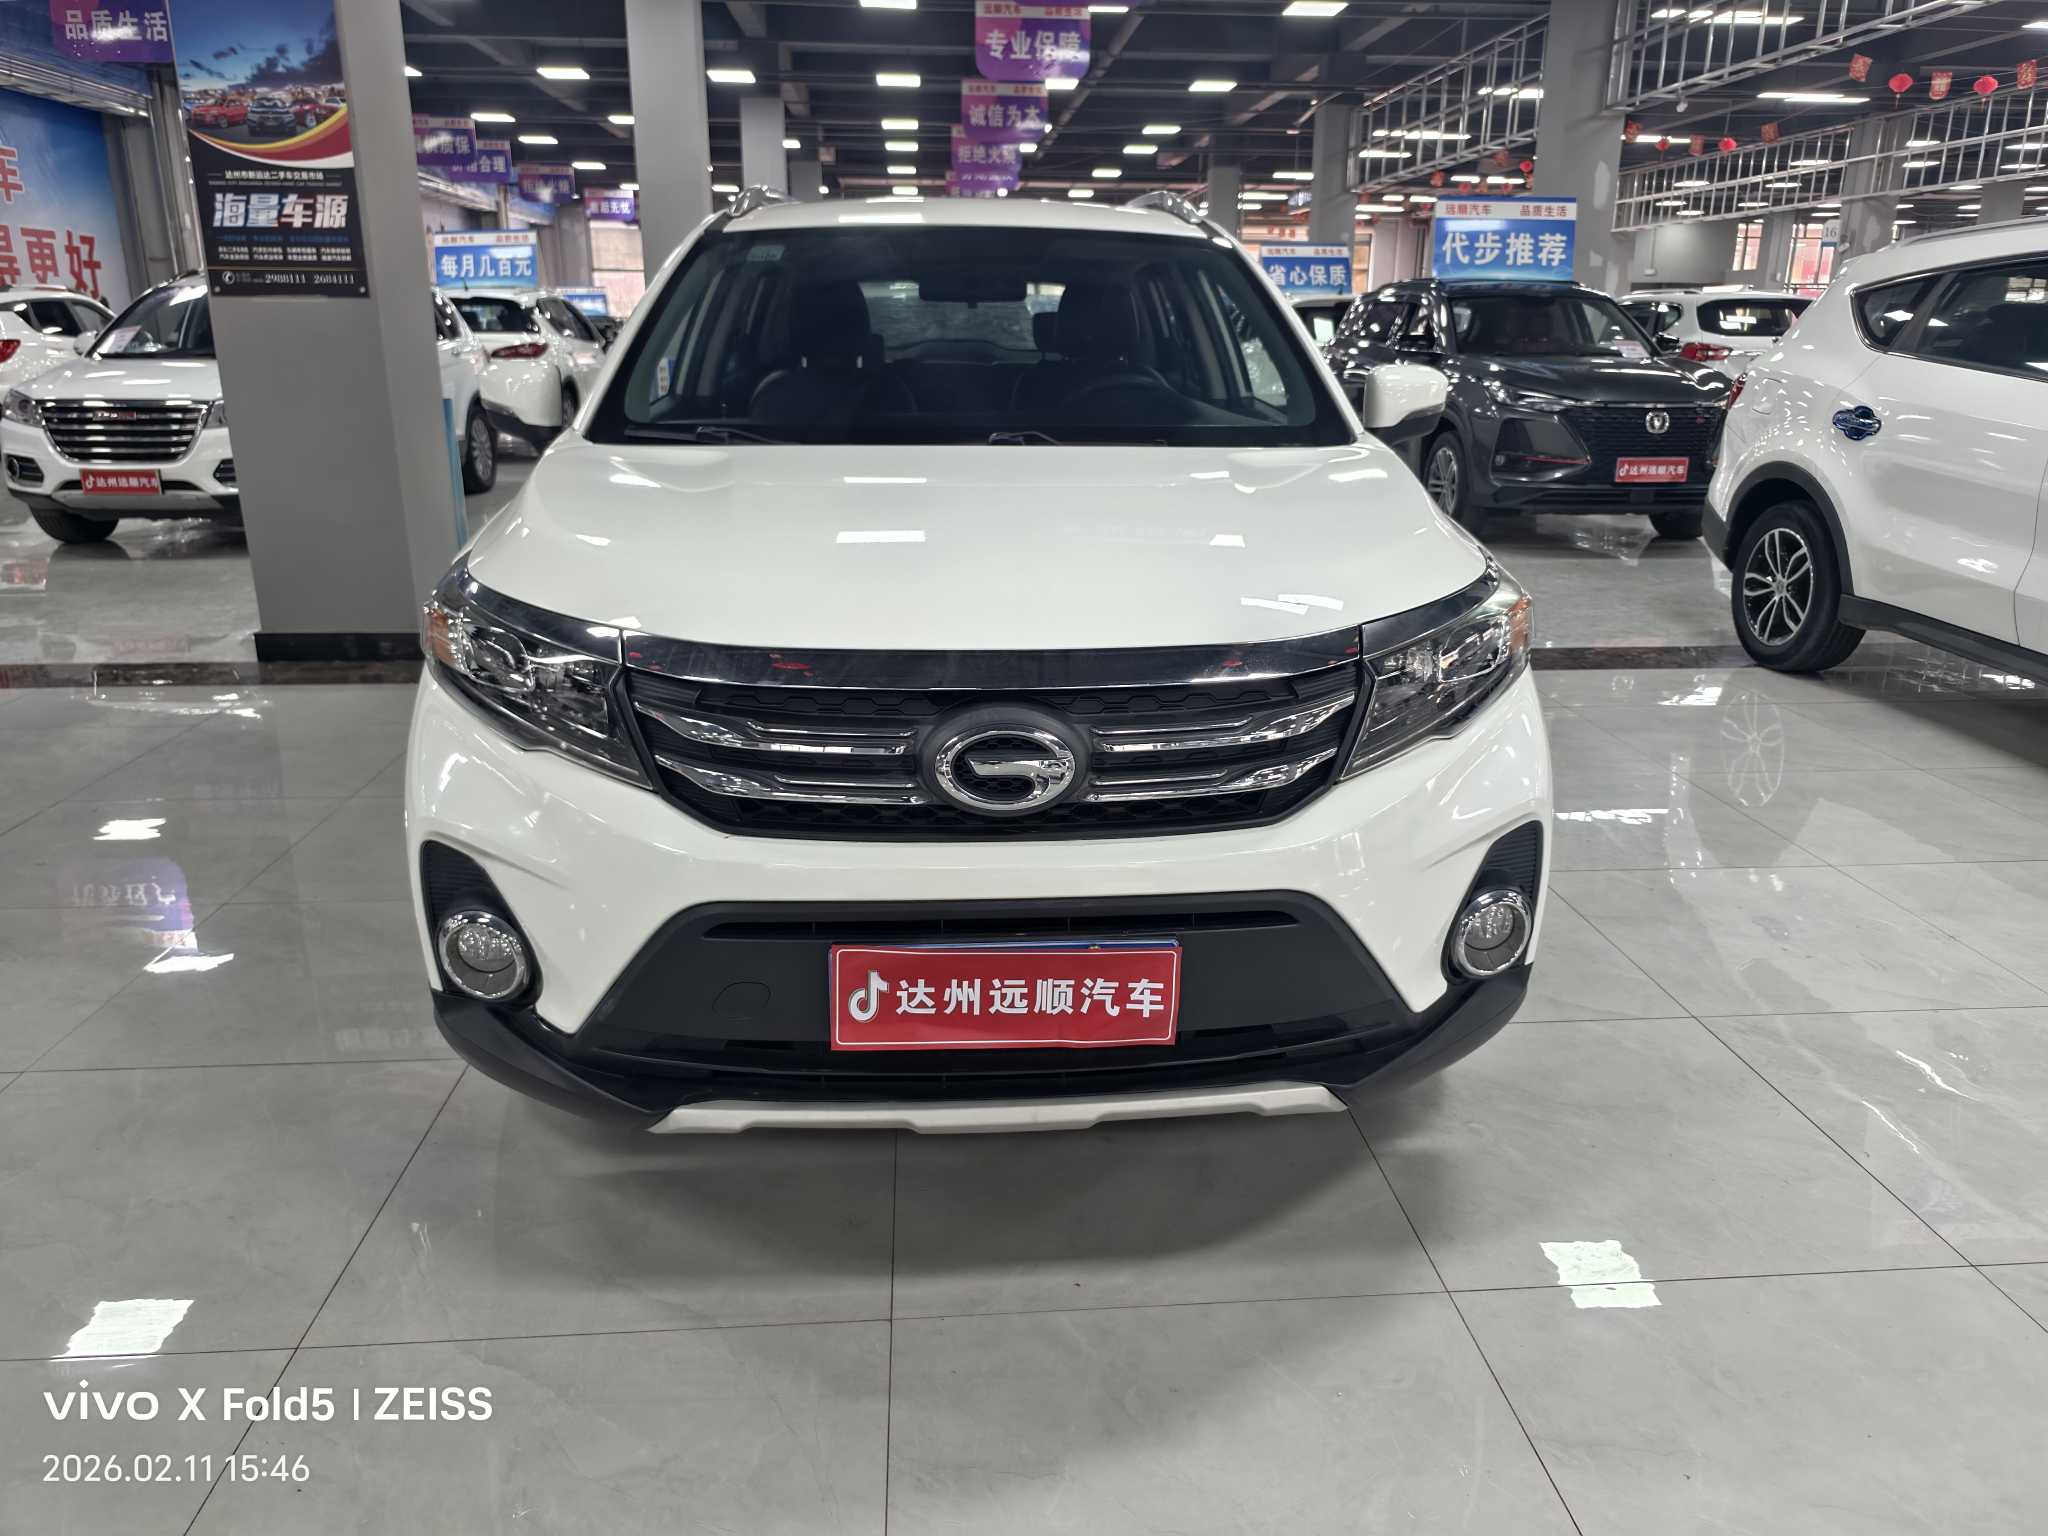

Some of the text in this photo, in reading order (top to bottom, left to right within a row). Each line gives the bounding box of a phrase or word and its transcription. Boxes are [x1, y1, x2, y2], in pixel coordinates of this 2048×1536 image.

[65, 9, 168, 41] 品质生活
[985, 30, 1081, 60] 专业保障
[213, 193, 349, 229] 海量车源
[1445, 203, 1567, 217] 远顺汽车 品质生活
[1442, 231, 1567, 267] 代步推荐
[441, 254, 533, 279] 每月几百元
[1268, 263, 1348, 287] 省心保质
[896, 978, 1165, 1018] 达州远顺汽车
